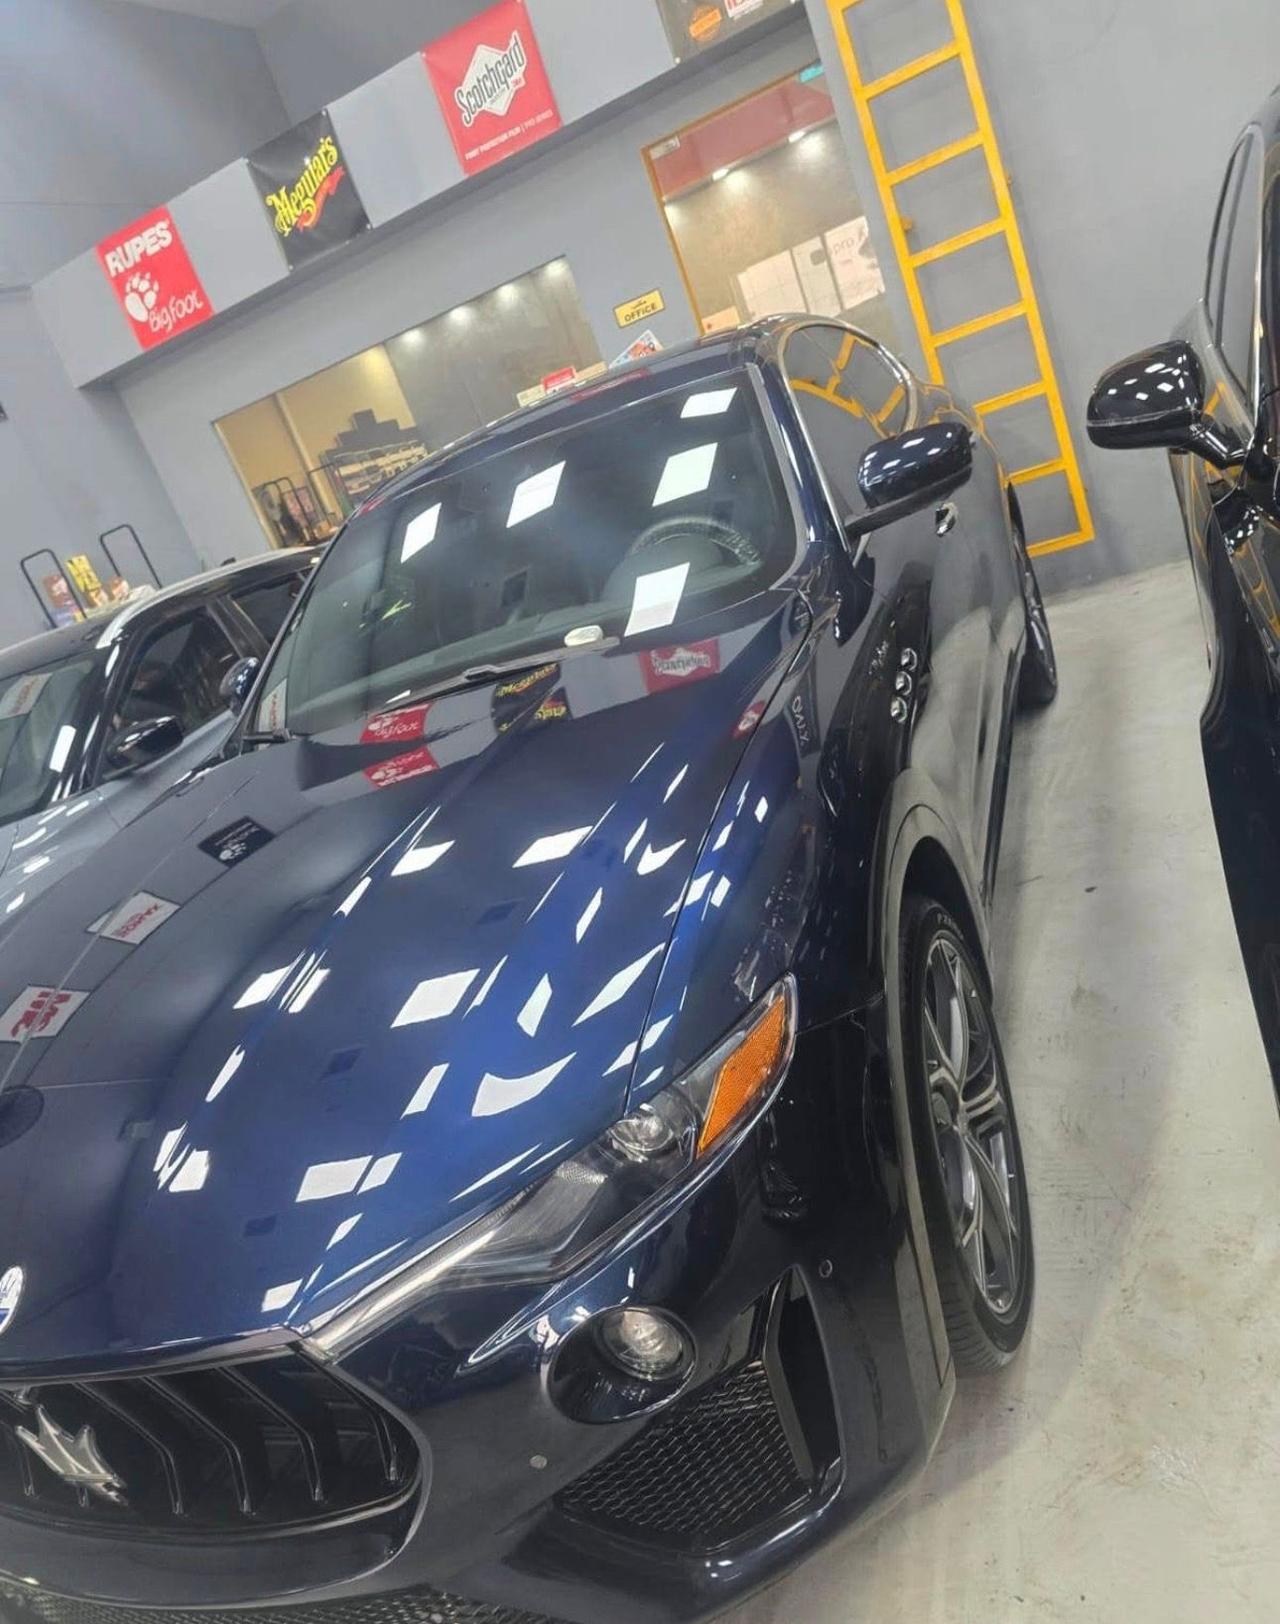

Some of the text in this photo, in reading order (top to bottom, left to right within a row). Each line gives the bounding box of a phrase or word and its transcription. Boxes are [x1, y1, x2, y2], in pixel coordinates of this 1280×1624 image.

[457, 35, 525, 125] Scotchgard
[105, 220, 172, 278] RUPES
[624, 303, 656, 322] OFFICE
